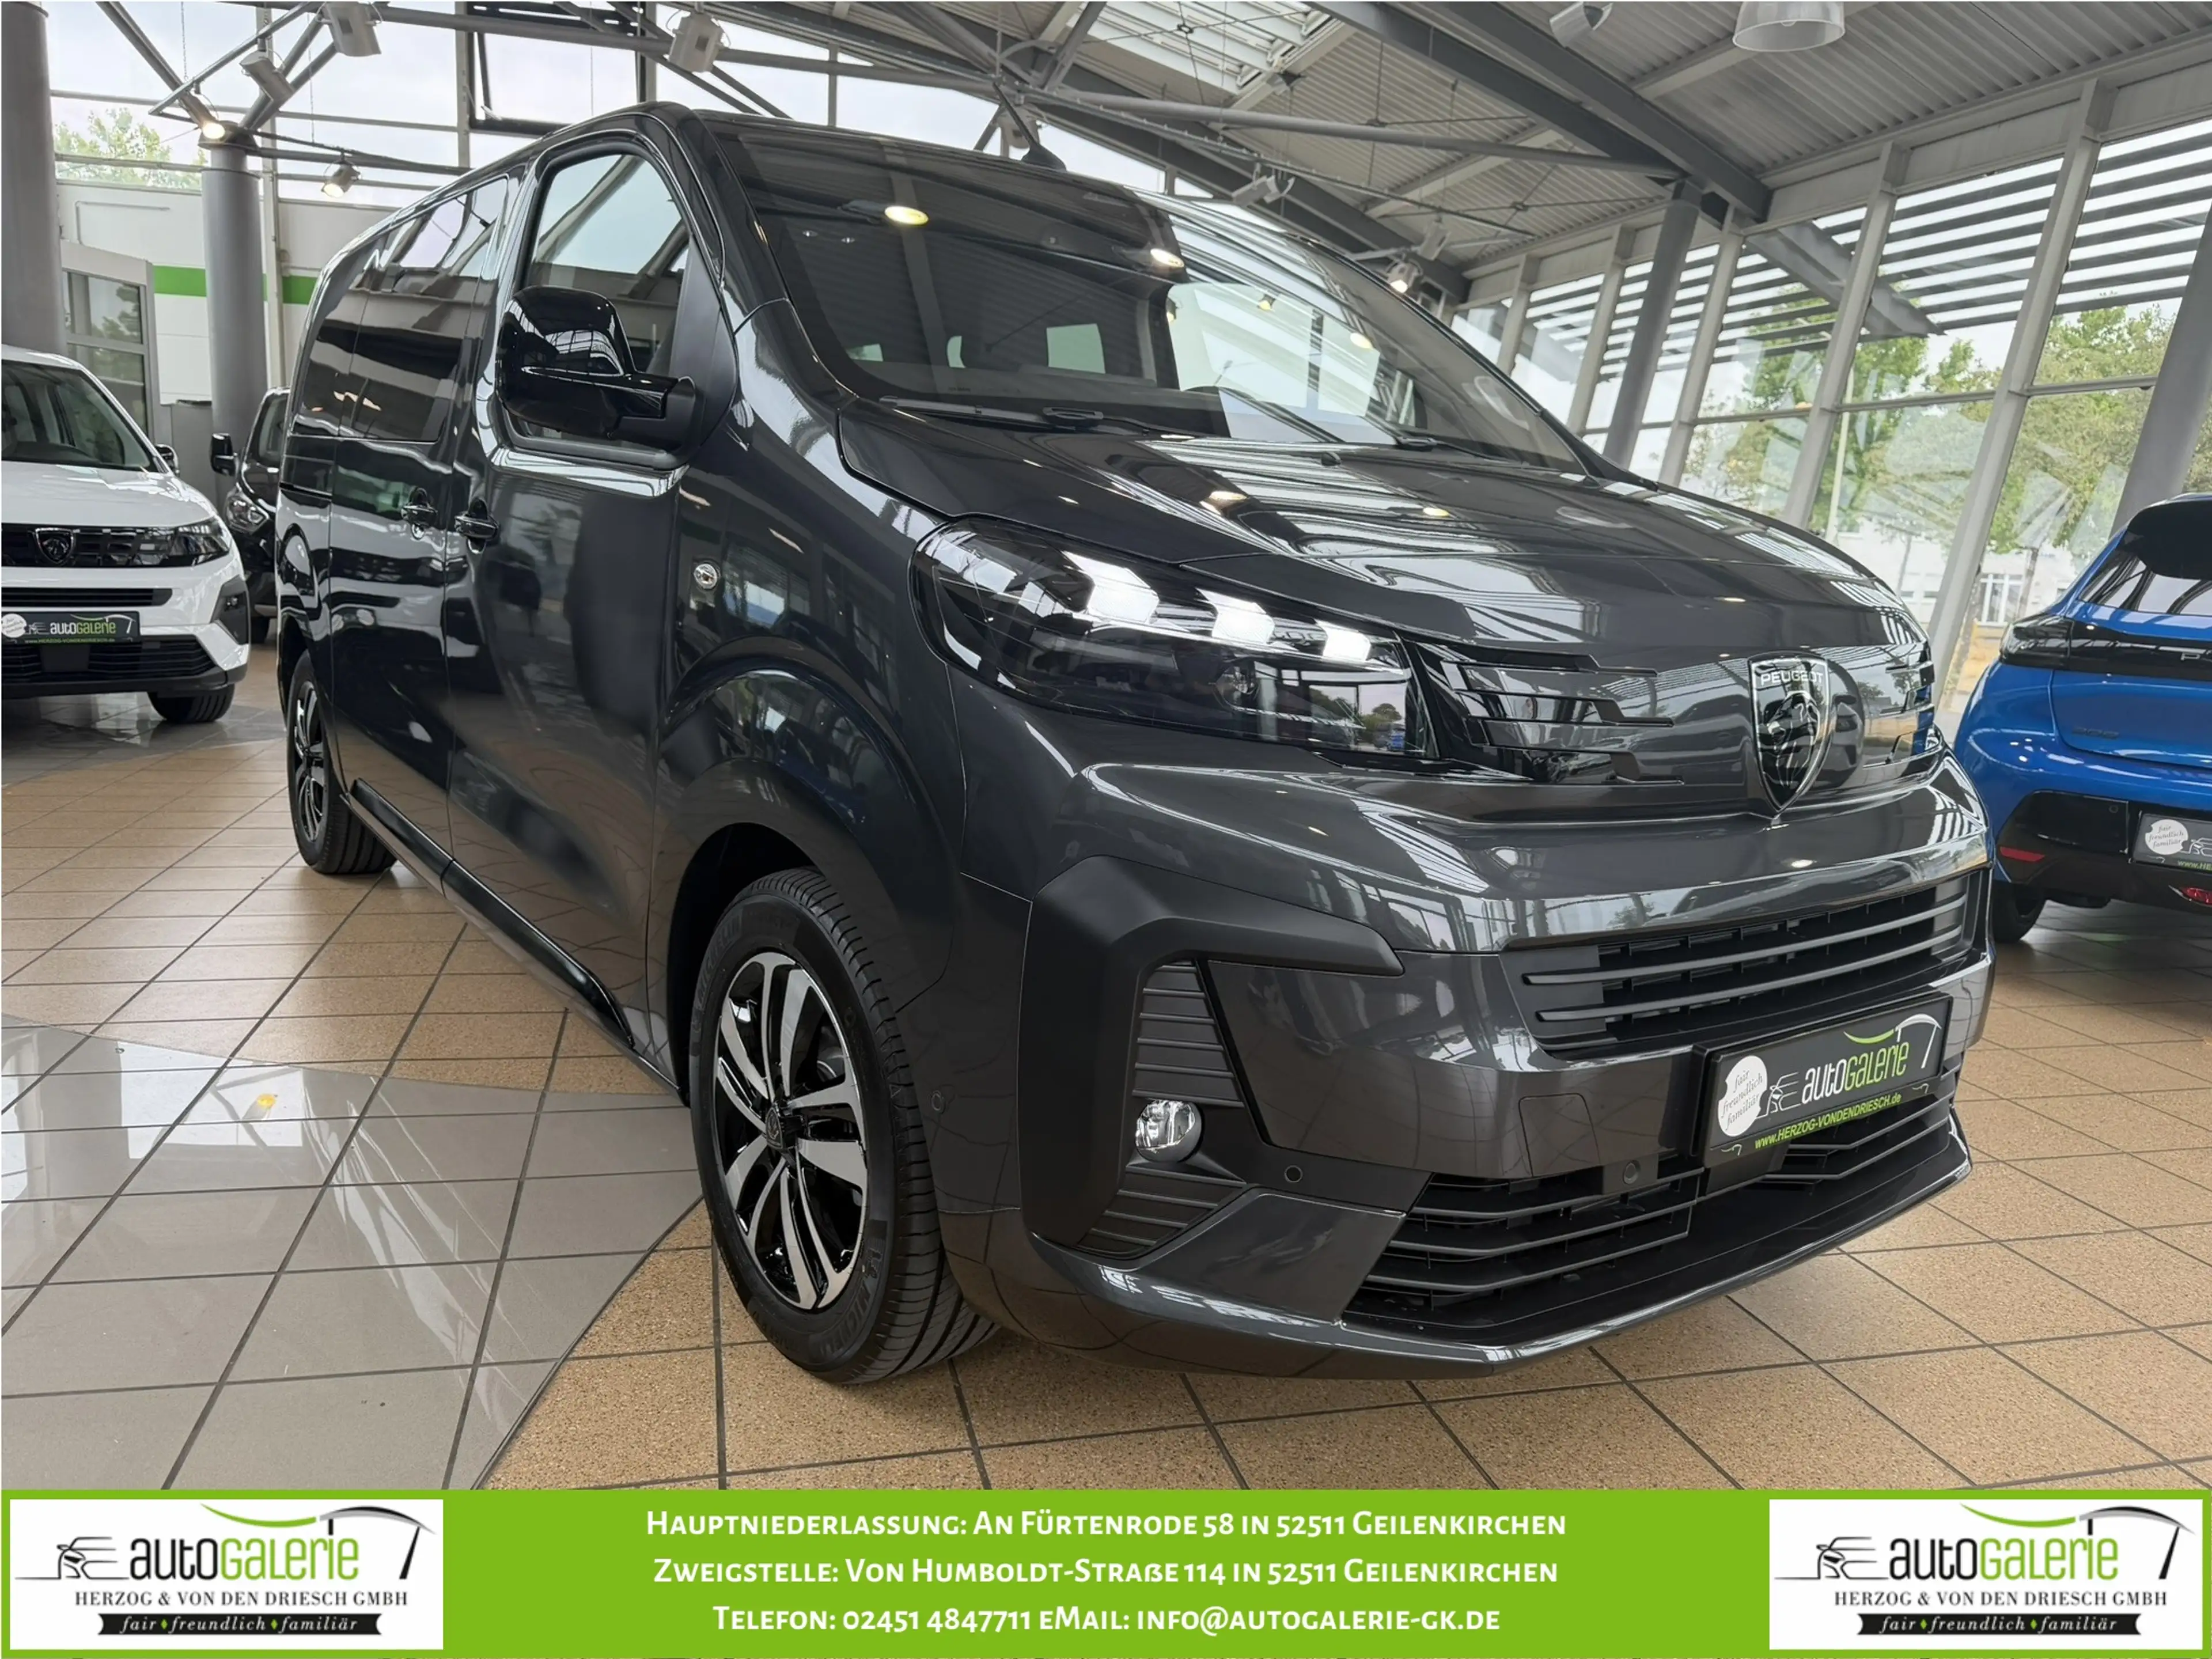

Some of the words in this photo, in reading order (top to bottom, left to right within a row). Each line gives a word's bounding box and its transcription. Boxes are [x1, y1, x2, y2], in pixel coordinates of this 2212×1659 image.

[1760, 670, 1823, 686] PEUGEOT
[1721, 1073, 1763, 1119] freundlich
[1733, 1070, 1749, 1093] fair
[1755, 1093, 1902, 1149] www.HERZOG-VONDENDRIESCH.de
